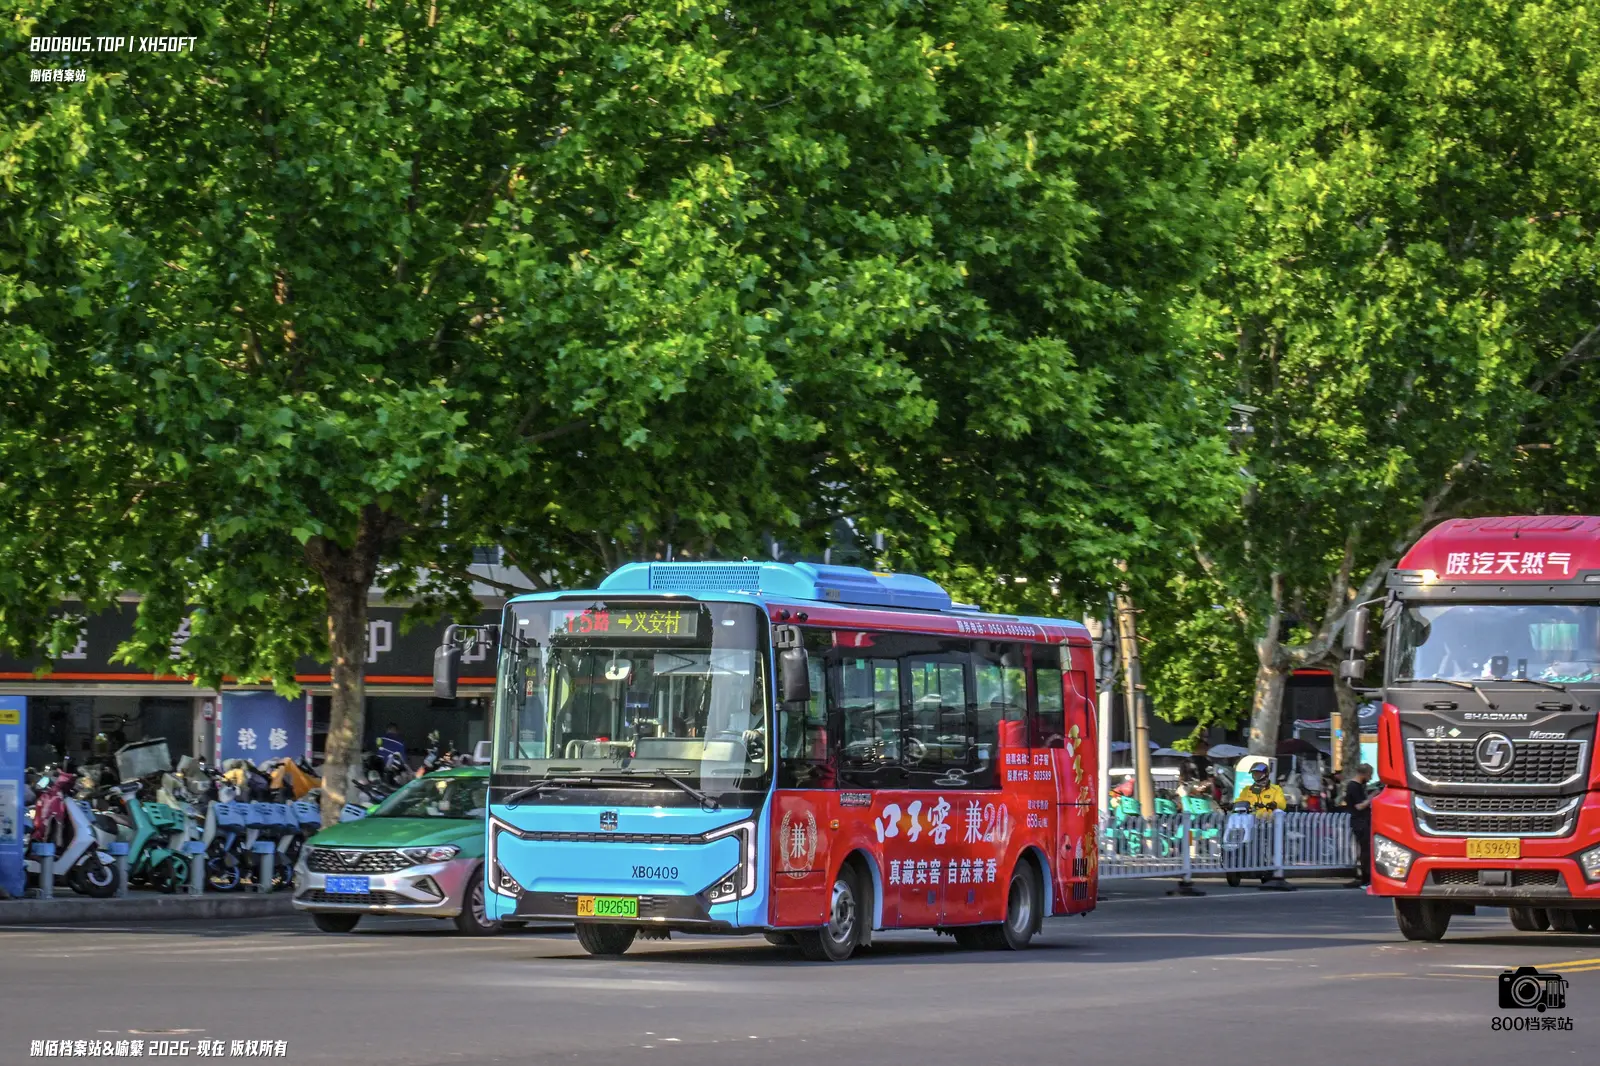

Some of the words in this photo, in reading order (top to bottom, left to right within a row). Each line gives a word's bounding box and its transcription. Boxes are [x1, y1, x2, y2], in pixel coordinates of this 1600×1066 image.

[1445, 551, 1572, 575] 陕汽天然气
[565, 609, 610, 633] 15路
[632, 610, 682, 634] 义安村
[1528, 730, 1566, 740] M5000
[875, 796, 951, 845] 口子窖
[1470, 842, 1518, 855] AS9693
[632, 865, 679, 880] XB0409
